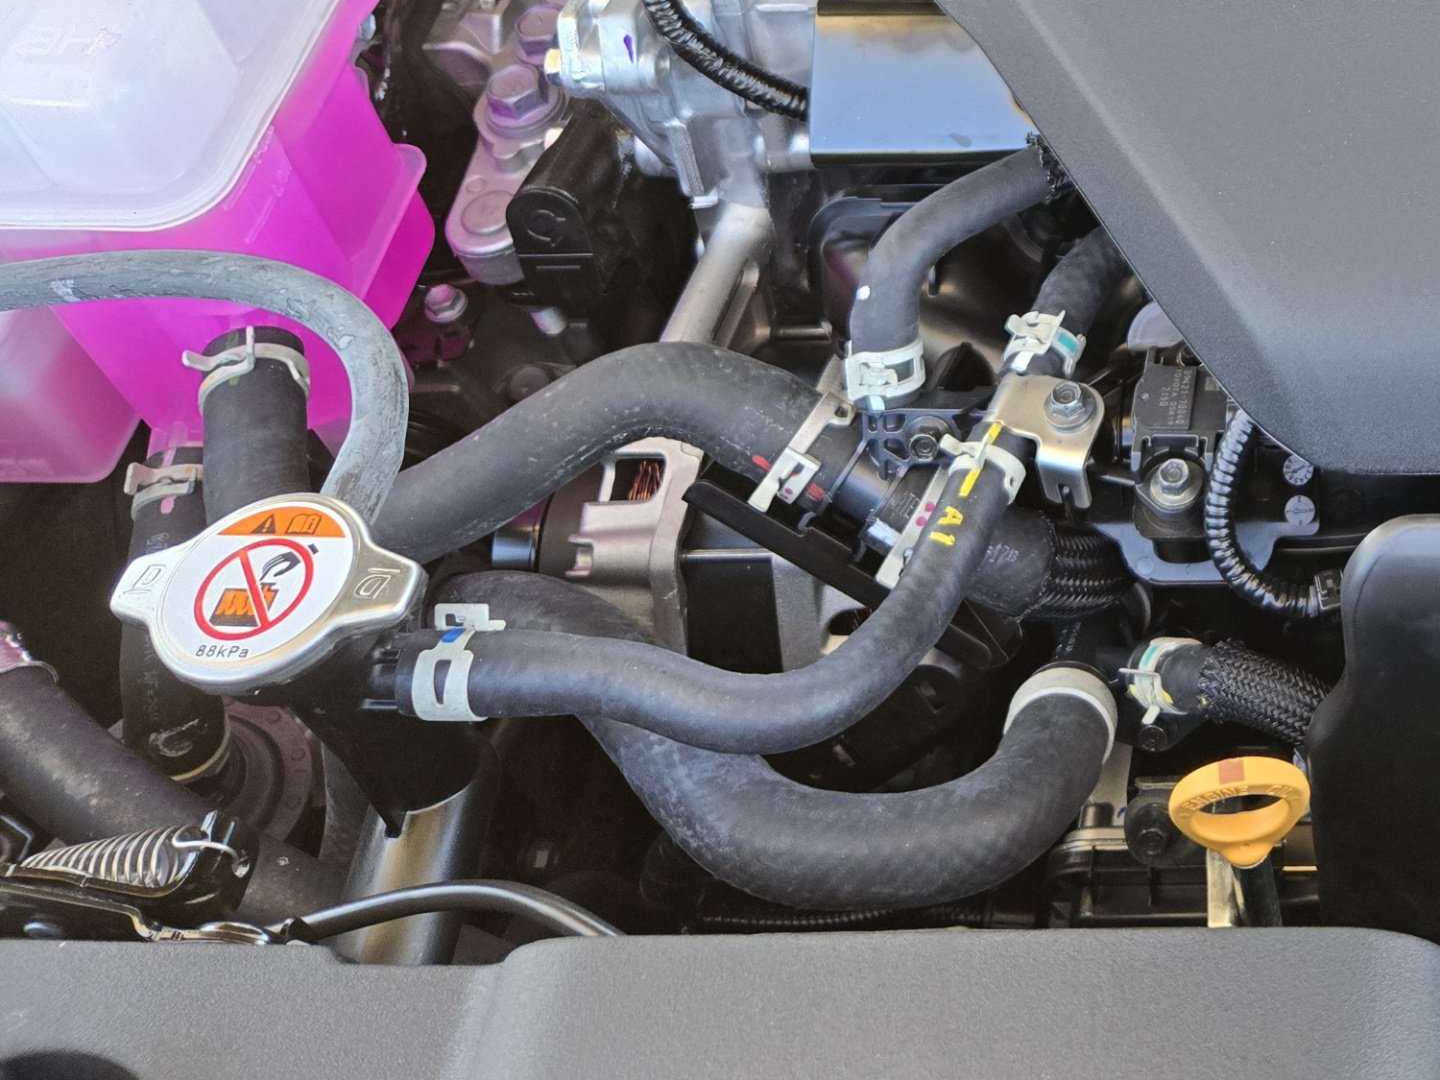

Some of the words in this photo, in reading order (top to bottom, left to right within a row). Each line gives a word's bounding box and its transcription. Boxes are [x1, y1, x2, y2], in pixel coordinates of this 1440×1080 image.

[929, 505, 964, 546] A1
[195, 644, 249, 659] 88kPa
[1181, 784, 1249, 811] ENGINE
